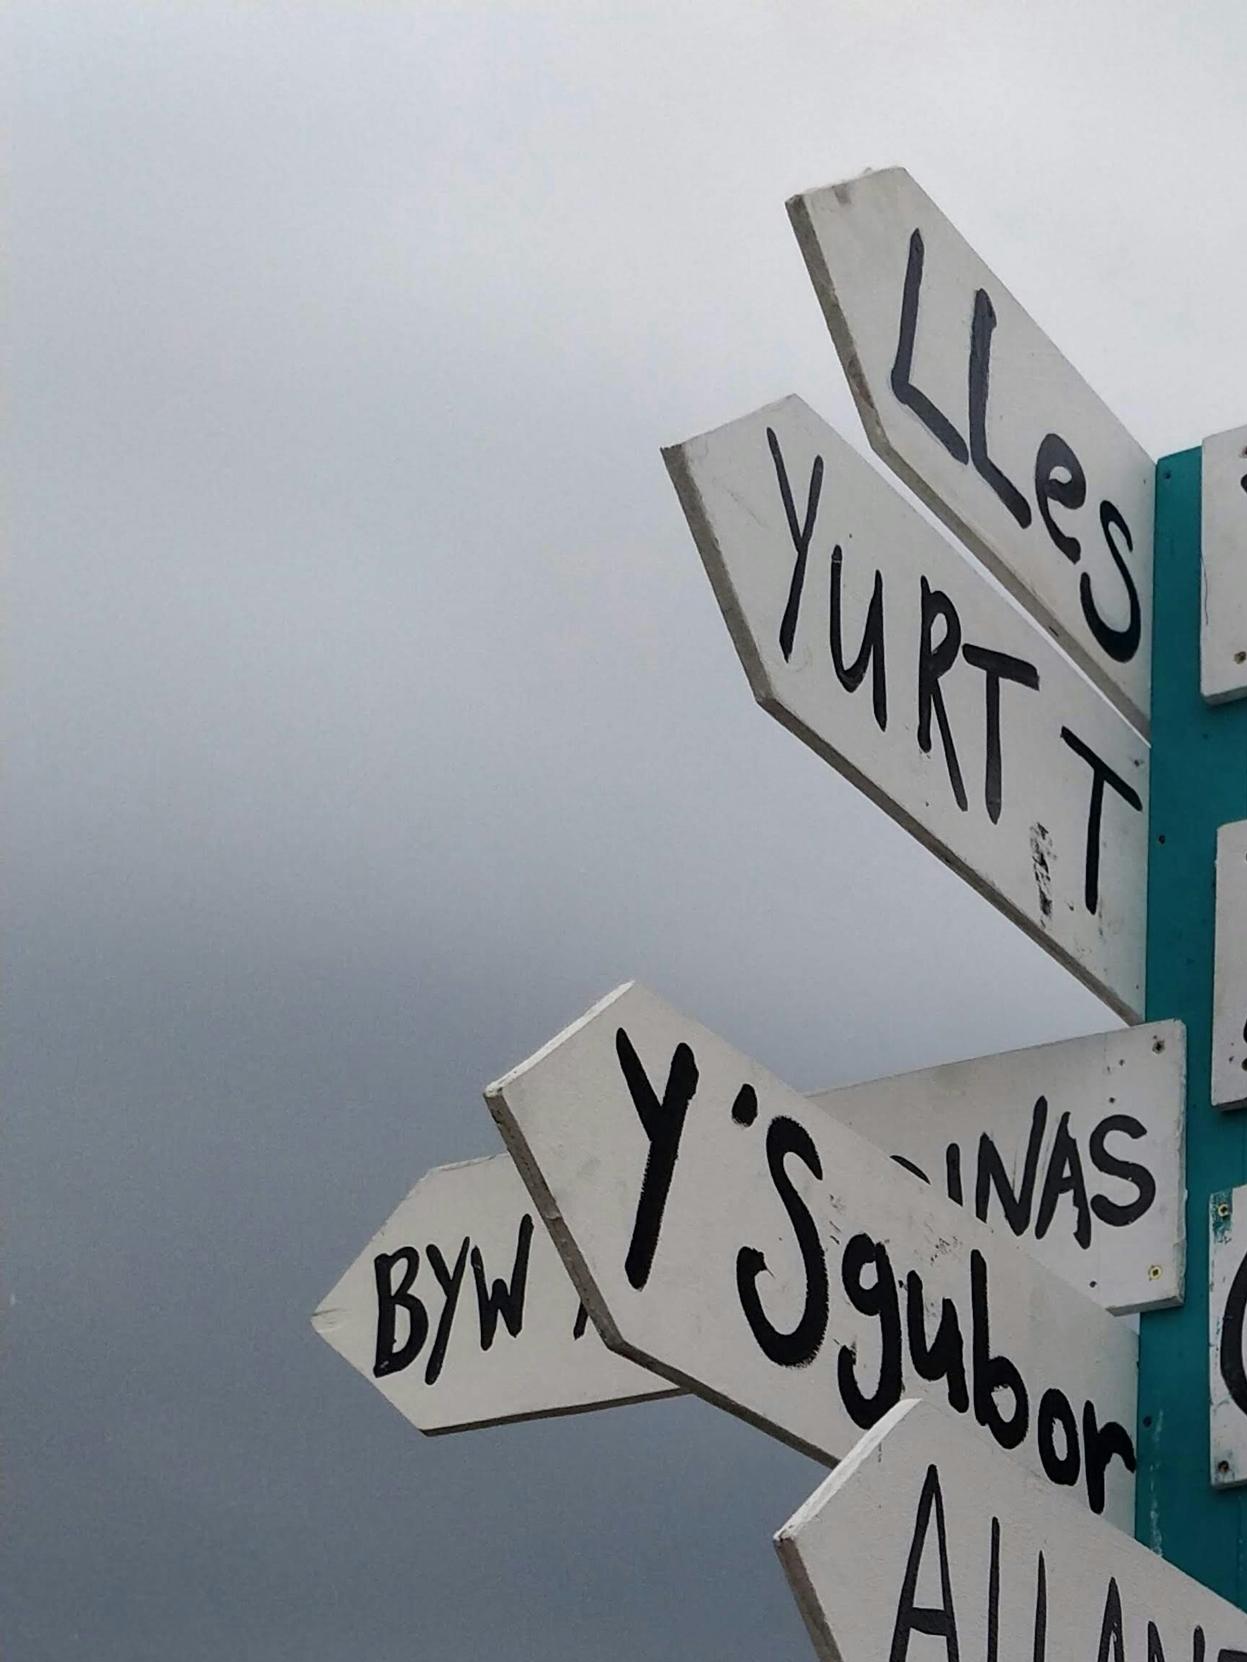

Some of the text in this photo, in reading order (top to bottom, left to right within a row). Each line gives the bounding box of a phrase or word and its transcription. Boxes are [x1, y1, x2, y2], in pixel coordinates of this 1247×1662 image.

[767, 428, 1143, 915] YURT T
[373, 1096, 1156, 1385] BYW INAS
